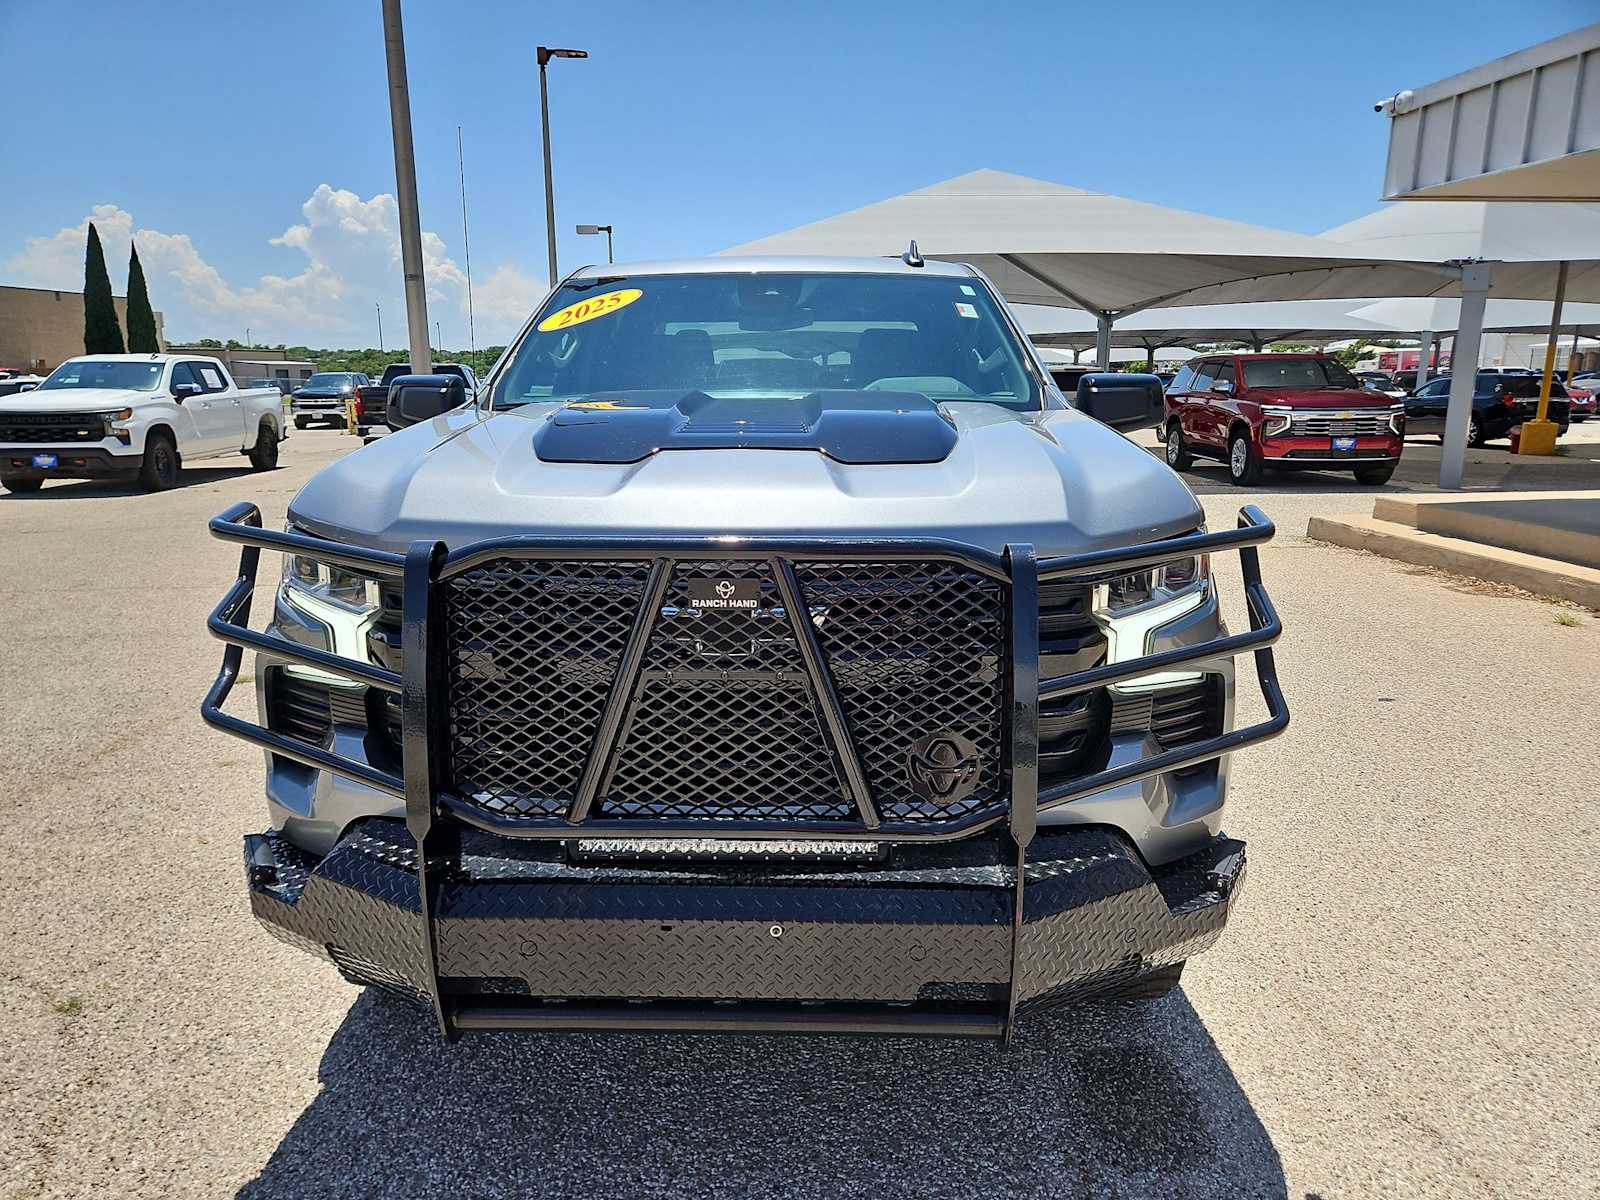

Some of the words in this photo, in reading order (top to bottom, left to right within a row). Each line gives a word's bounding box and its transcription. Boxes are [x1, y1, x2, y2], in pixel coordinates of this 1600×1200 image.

[559, 292, 622, 326] 2025
[691, 599, 727, 608] RANCH
[729, 599, 758, 608] HAND
